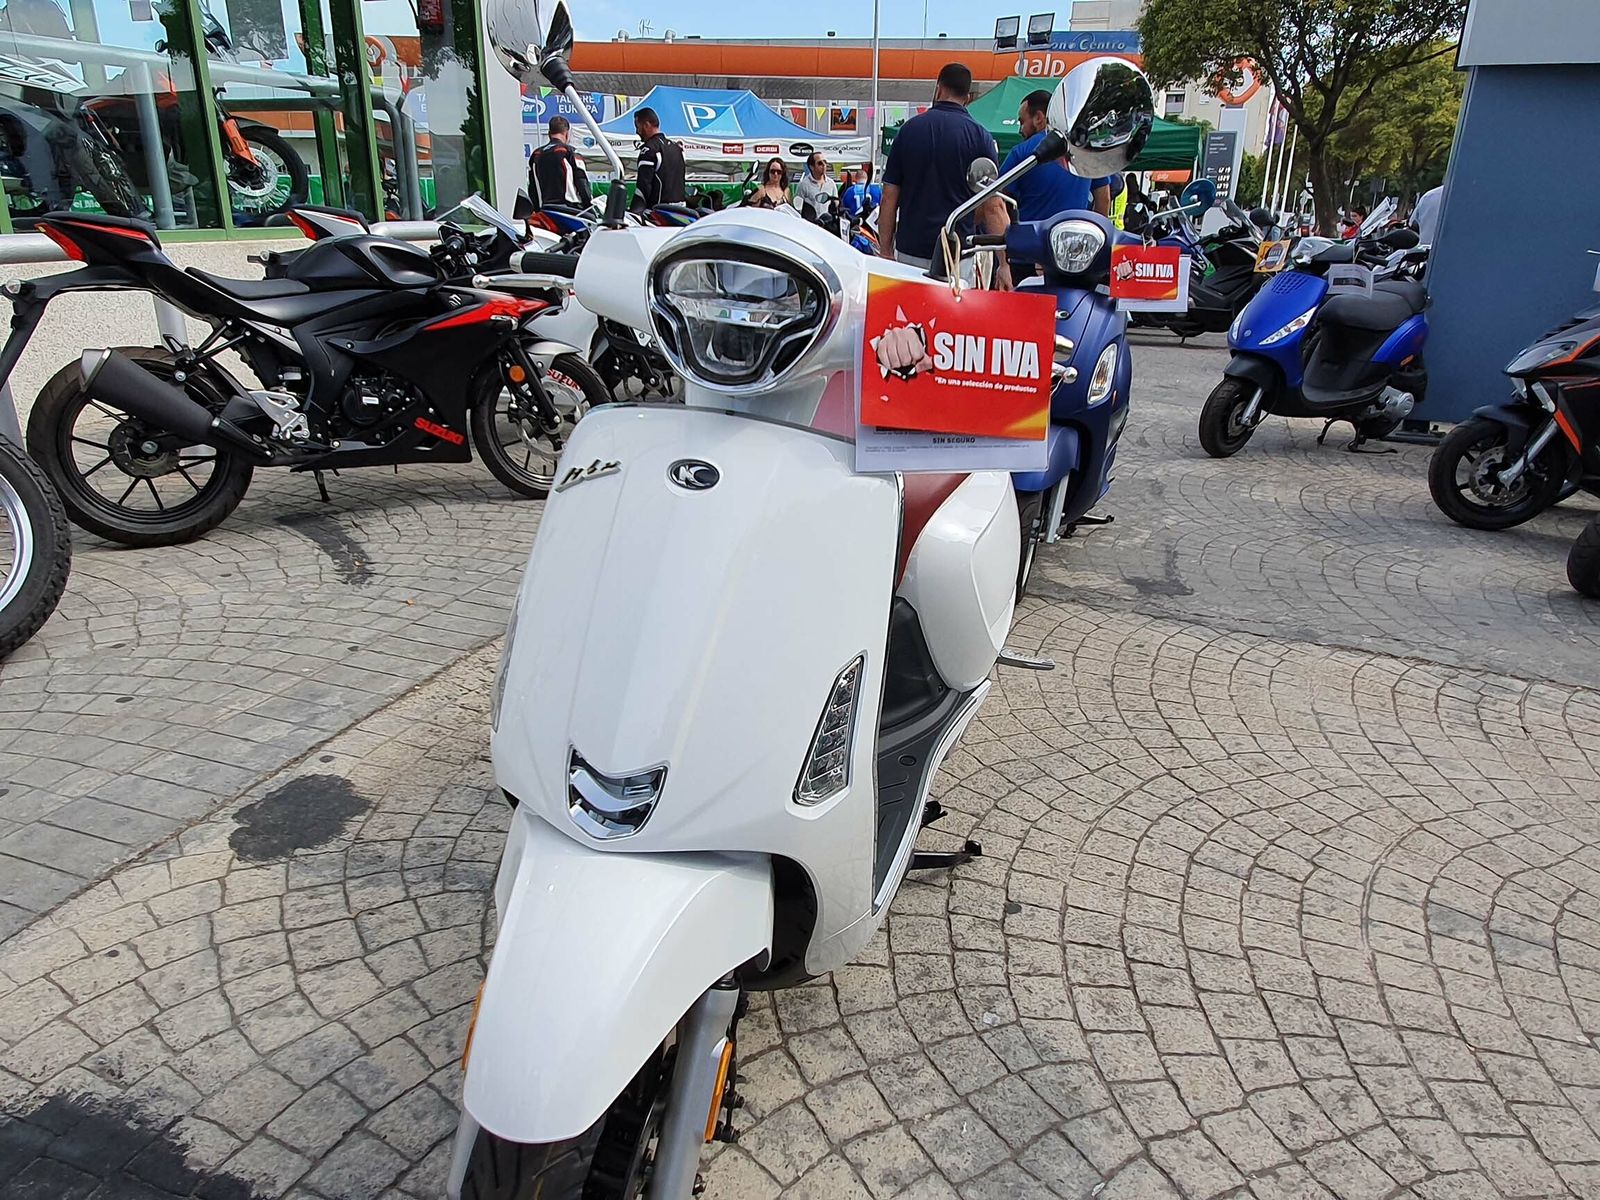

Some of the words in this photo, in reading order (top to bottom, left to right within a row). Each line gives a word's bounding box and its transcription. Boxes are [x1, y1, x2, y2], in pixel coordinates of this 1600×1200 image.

[1079, 38, 1126, 51] Centro
[1014, 54, 1066, 78] galp
[558, 104, 598, 114] EURPA
[1135, 262, 1154, 277] SIN
[1155, 264, 1174, 278] IVA
[934, 332, 986, 374] SIN
[991, 338, 1040, 380] IVA
[1004, 384, 1036, 393] productos
[414, 416, 465, 446] SUZUKI
